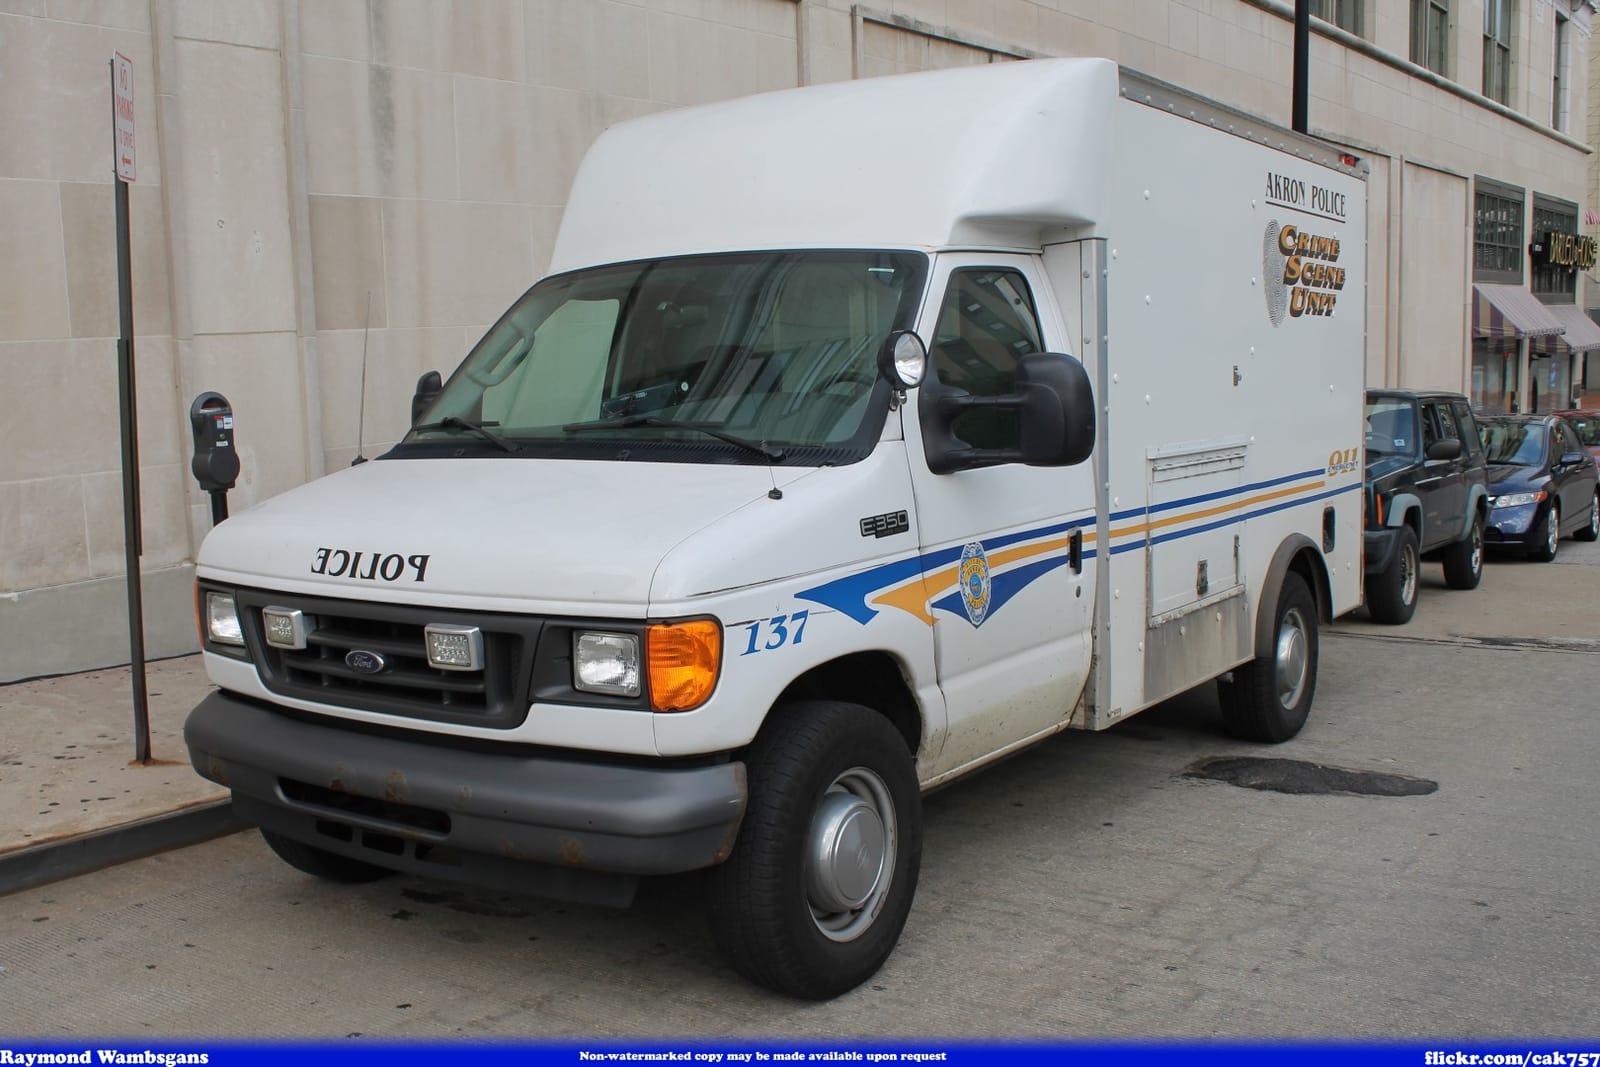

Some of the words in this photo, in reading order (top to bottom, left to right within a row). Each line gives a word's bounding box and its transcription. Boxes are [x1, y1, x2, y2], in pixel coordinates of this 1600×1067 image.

[1265, 172, 1306, 207] AKRON
[1311, 185, 1346, 218] POLICE
[1279, 224, 1340, 262] CRIME
[1283, 254, 1346, 290] SCENE
[1289, 286, 1337, 318] UNIT
[739, 609, 809, 656] 137
